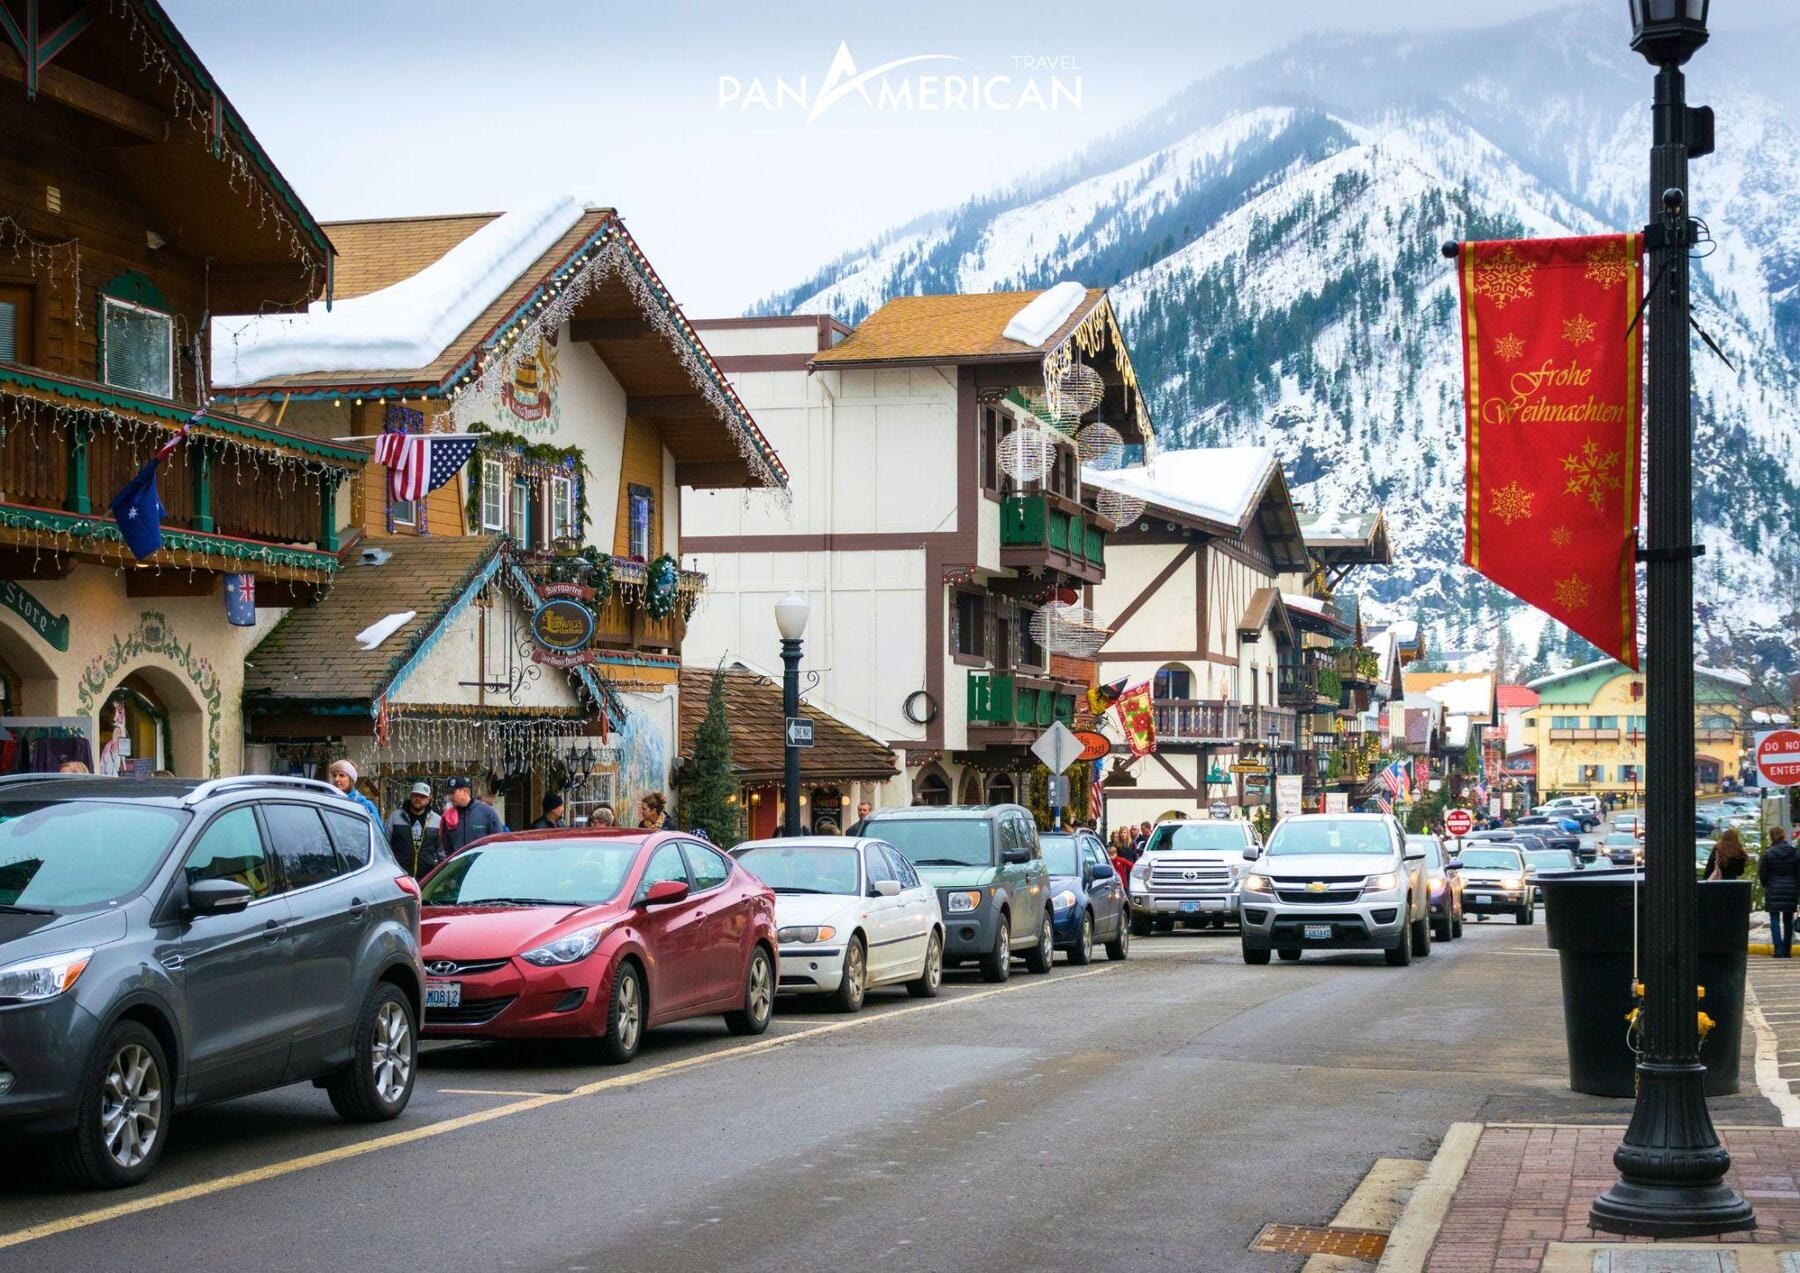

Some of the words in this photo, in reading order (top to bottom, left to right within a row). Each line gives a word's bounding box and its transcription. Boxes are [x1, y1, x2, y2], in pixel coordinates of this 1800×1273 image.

[1510, 359, 1592, 396] Frohe
[1482, 395, 1625, 424] Weihnachten
[1765, 742, 1779, 751] DO
[1785, 741, 1800, 750] NO
